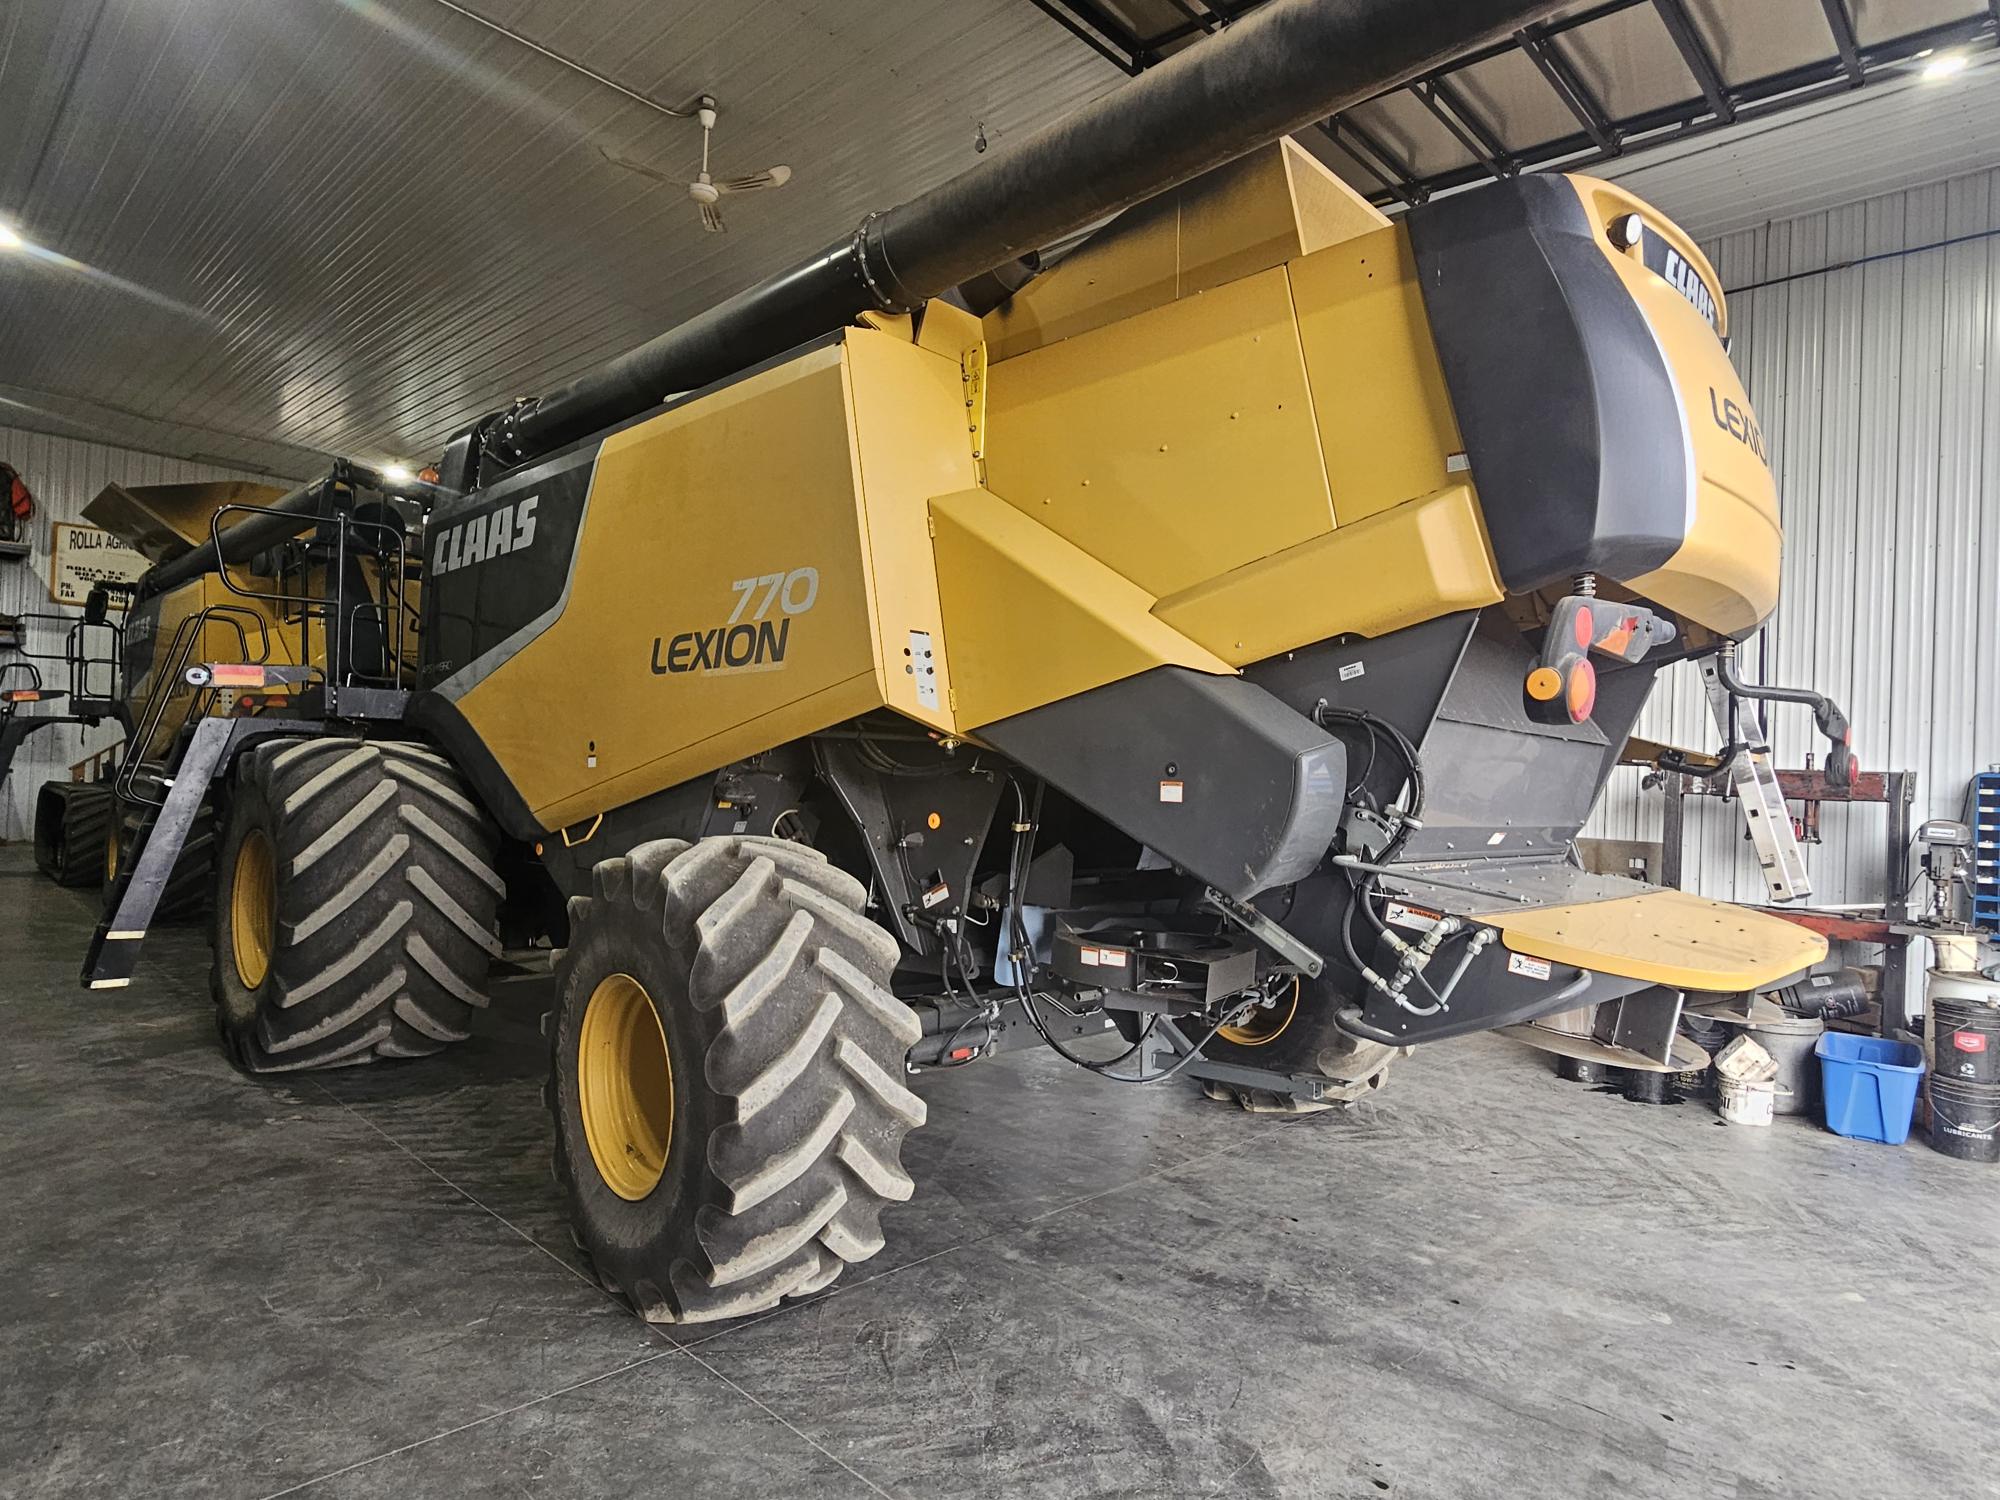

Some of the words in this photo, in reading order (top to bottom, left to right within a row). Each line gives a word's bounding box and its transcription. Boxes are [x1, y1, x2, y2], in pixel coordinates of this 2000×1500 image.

[1665, 249, 1715, 324] CLAAS
[69, 530, 102, 550] ROLLA
[431, 495, 539, 576] CLAAS
[60, 590, 75, 598] FAX
[727, 566, 819, 625] 770
[650, 617, 791, 675] LEXION
[1943, 1126, 1993, 1140] LUBRICANTS
